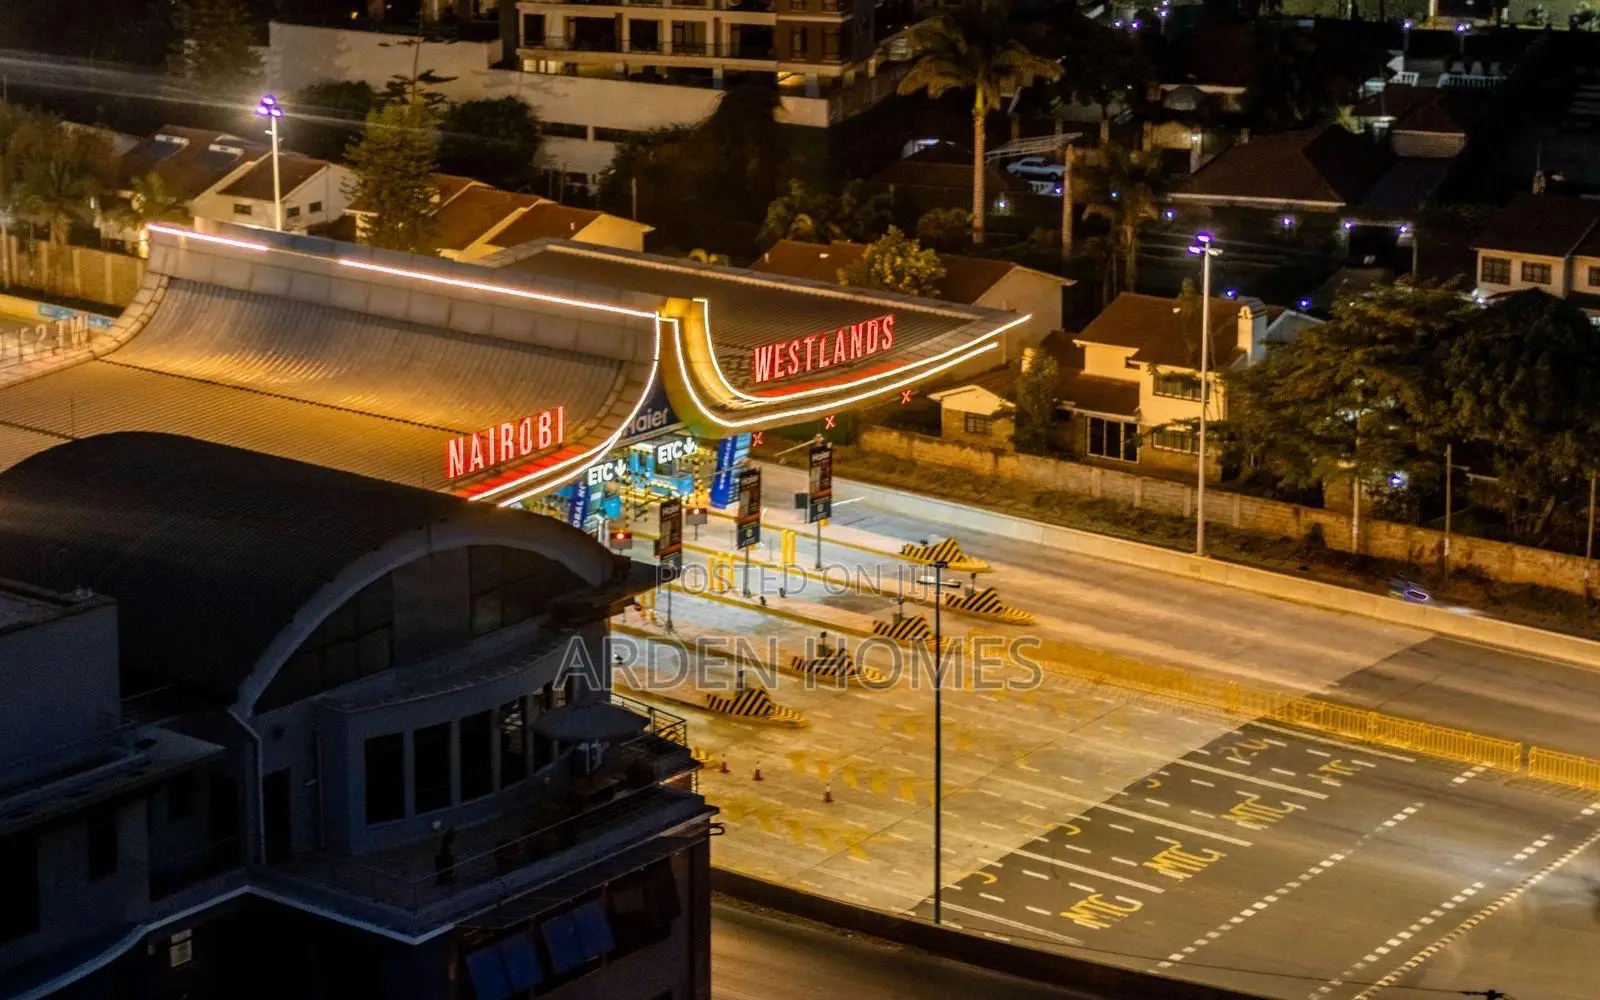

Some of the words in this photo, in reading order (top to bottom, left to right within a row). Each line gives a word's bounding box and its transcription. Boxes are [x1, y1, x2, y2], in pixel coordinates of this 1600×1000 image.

[754, 314, 895, 383] WESTLANDS
[447, 405, 565, 479] NAIROBI
[657, 440, 683, 465] ETC
[587, 462, 614, 486] ETC
[1220, 797, 1296, 831] MTC
[1143, 842, 1221, 880] MTC
[1060, 893, 1144, 929] MTC
